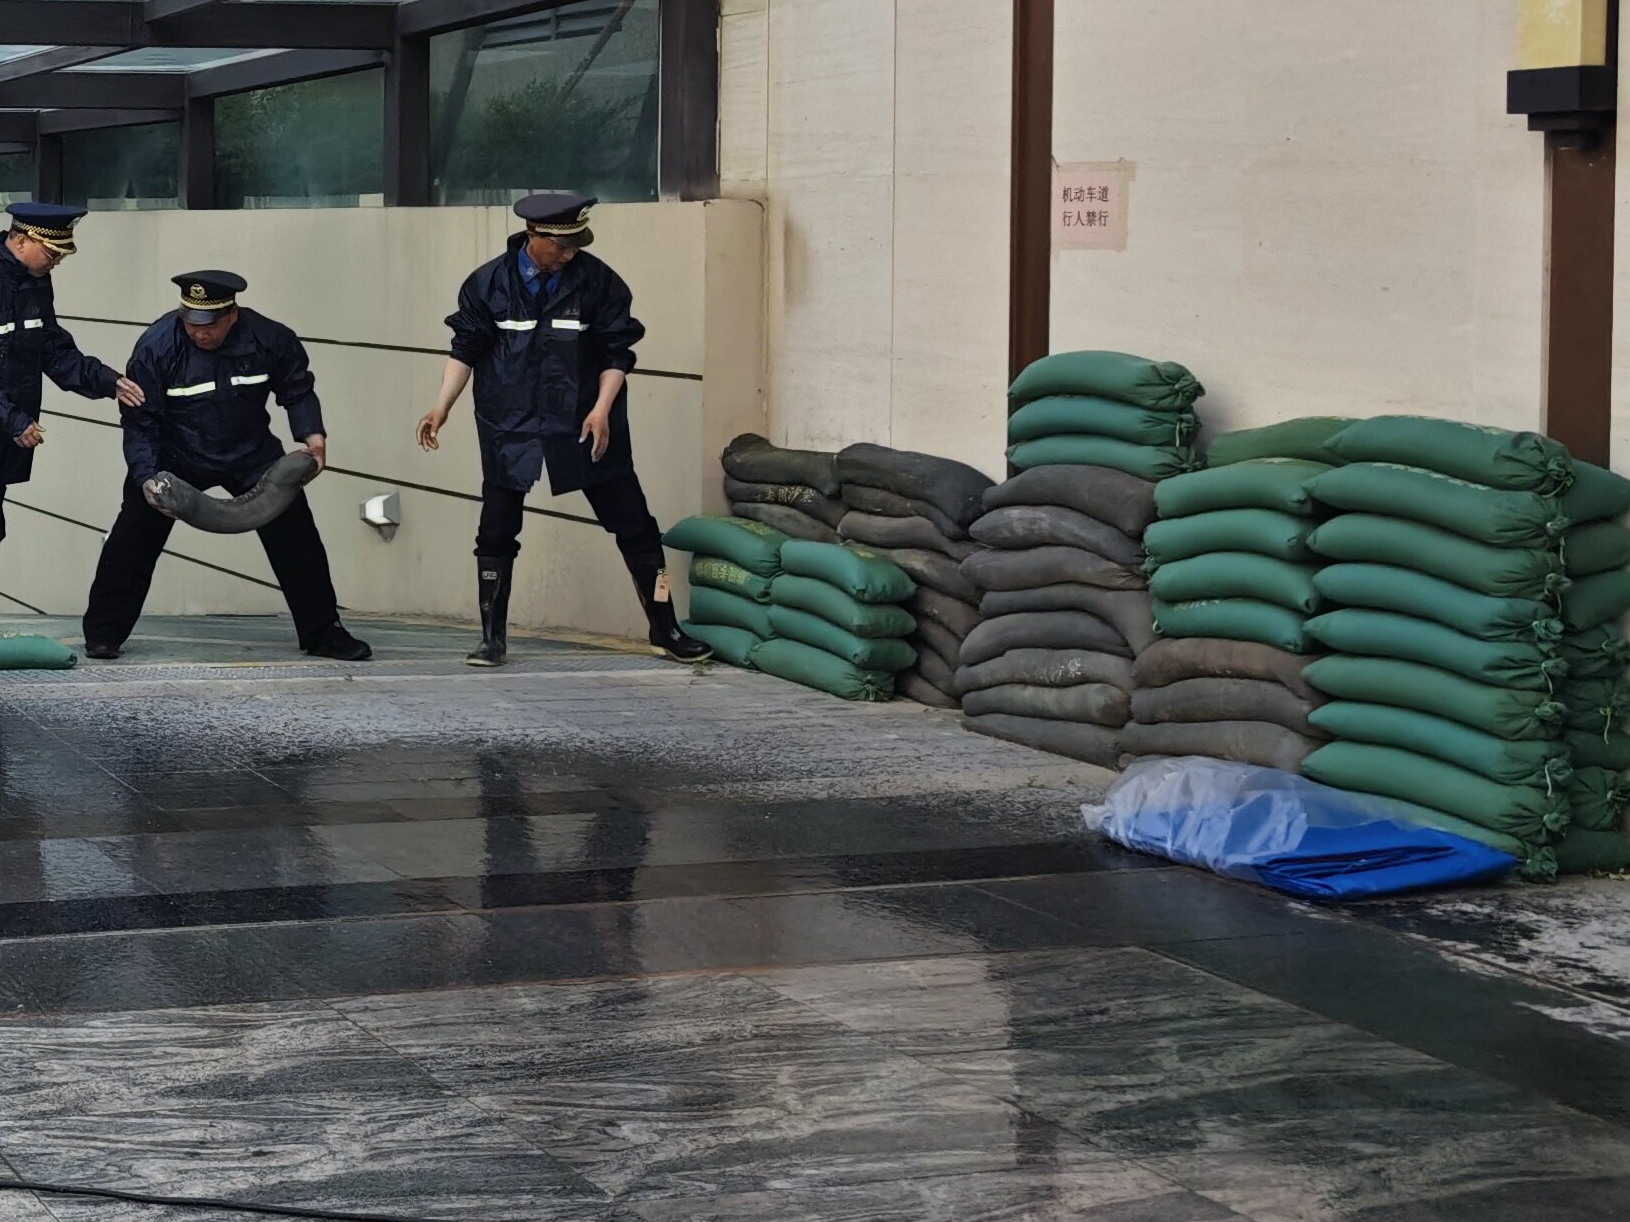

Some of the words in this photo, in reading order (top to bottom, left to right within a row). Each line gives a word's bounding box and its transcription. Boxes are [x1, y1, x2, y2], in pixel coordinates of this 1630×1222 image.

[1062, 186, 1109, 202] 机动车道
[1062, 210, 1109, 227] 行人禁行
